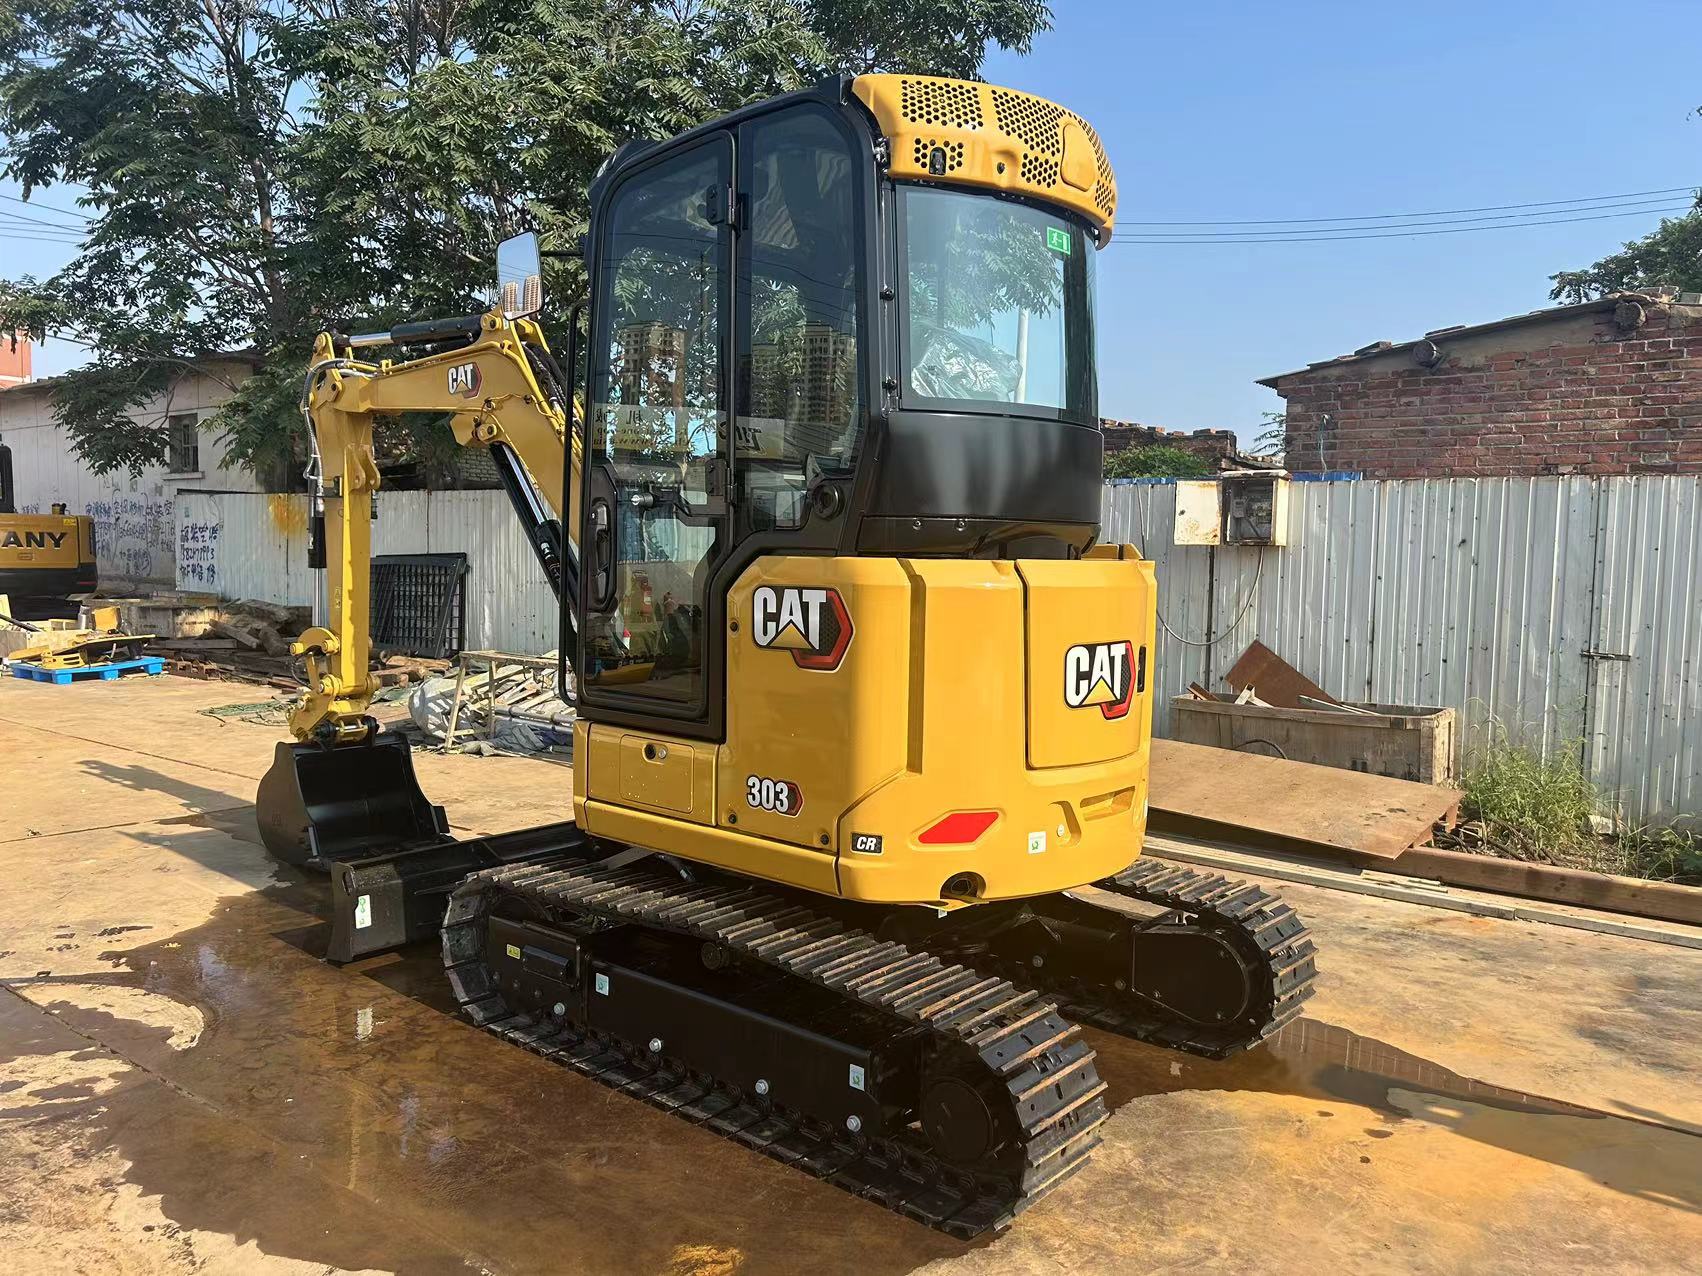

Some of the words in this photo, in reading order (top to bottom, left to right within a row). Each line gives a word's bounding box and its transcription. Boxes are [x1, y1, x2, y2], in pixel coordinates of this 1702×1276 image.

[448, 363, 473, 394] CAT
[753, 587, 827, 650] CAT
[1066, 643, 1126, 706] CAT
[747, 776, 789, 813] 303
[856, 836, 877, 850] CR
